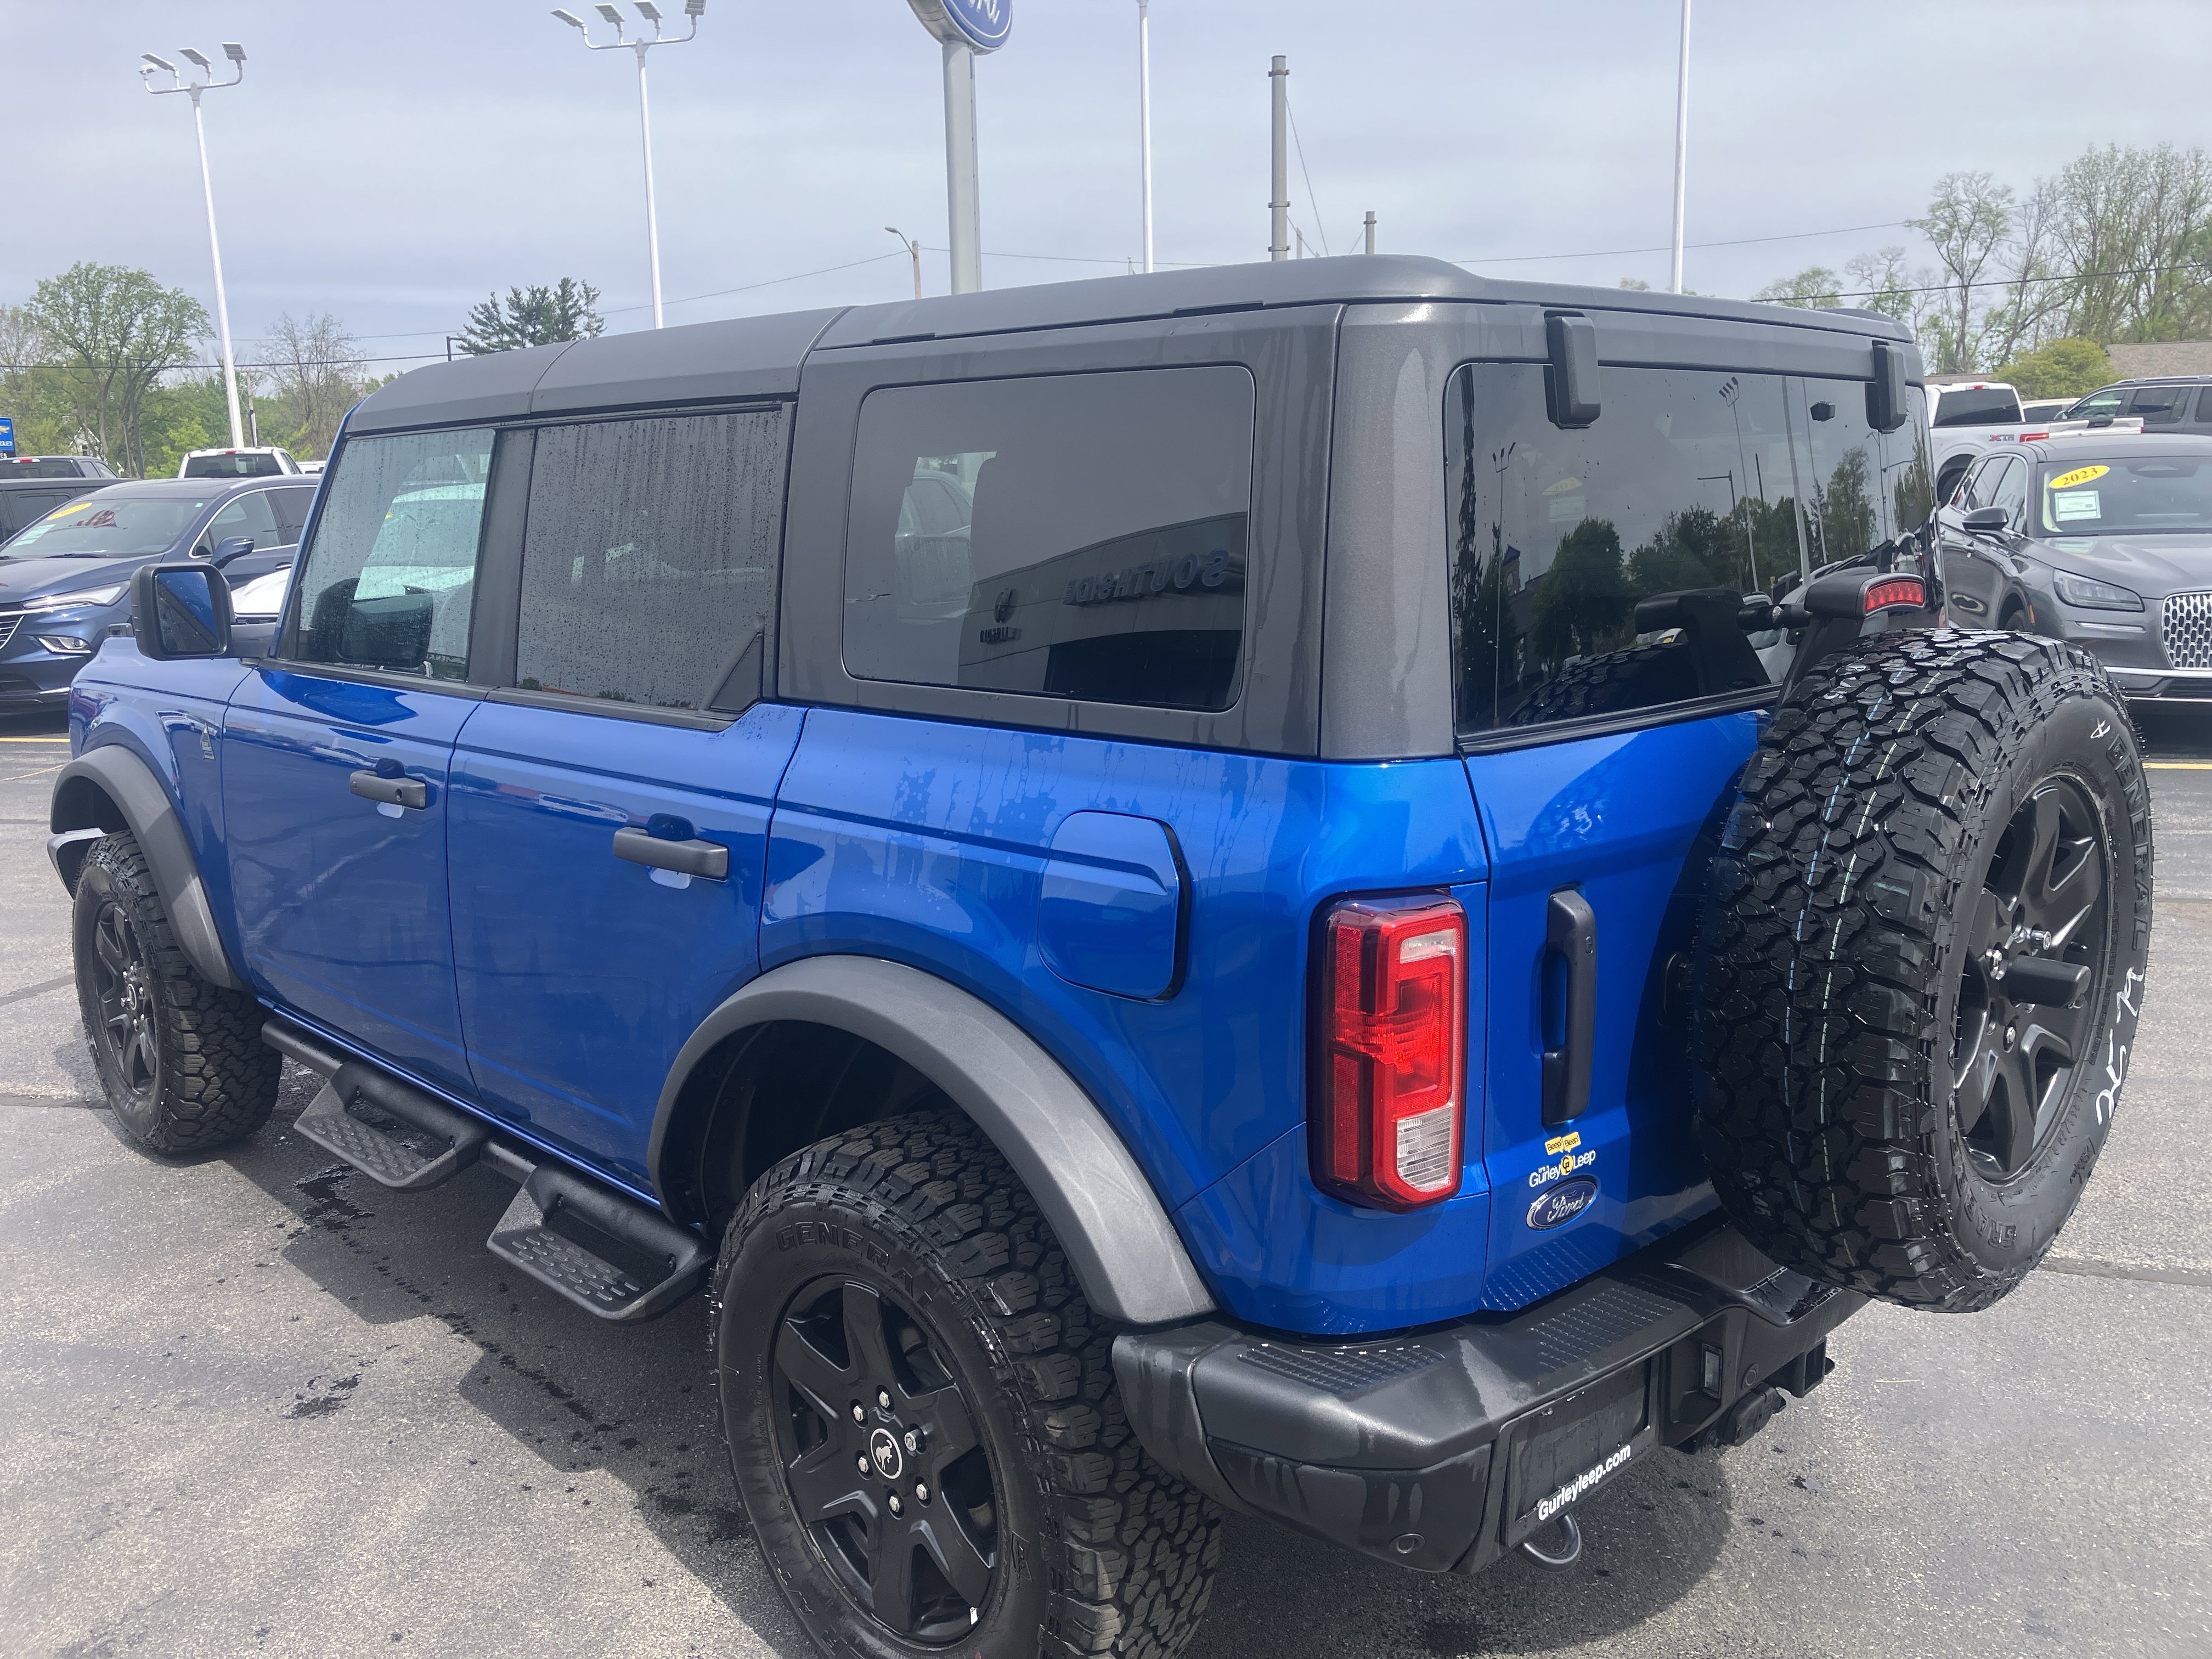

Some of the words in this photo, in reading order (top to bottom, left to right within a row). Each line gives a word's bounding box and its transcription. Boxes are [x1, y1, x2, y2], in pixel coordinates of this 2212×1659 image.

[2061, 467, 2098, 486] 2023
[2106, 733, 2150, 951] GENERAL
[1547, 1139, 1562, 1152] Beep!
[1564, 1135, 1579, 1147] Beep!
[1529, 1163, 1561, 1188] Gurley
[1572, 1150, 1596, 1170] Leep
[1547, 1189, 1585, 1223] Ford
[775, 1221, 938, 1327] GENERAL
[1538, 1444, 1631, 1521] Gurleyleep.com
